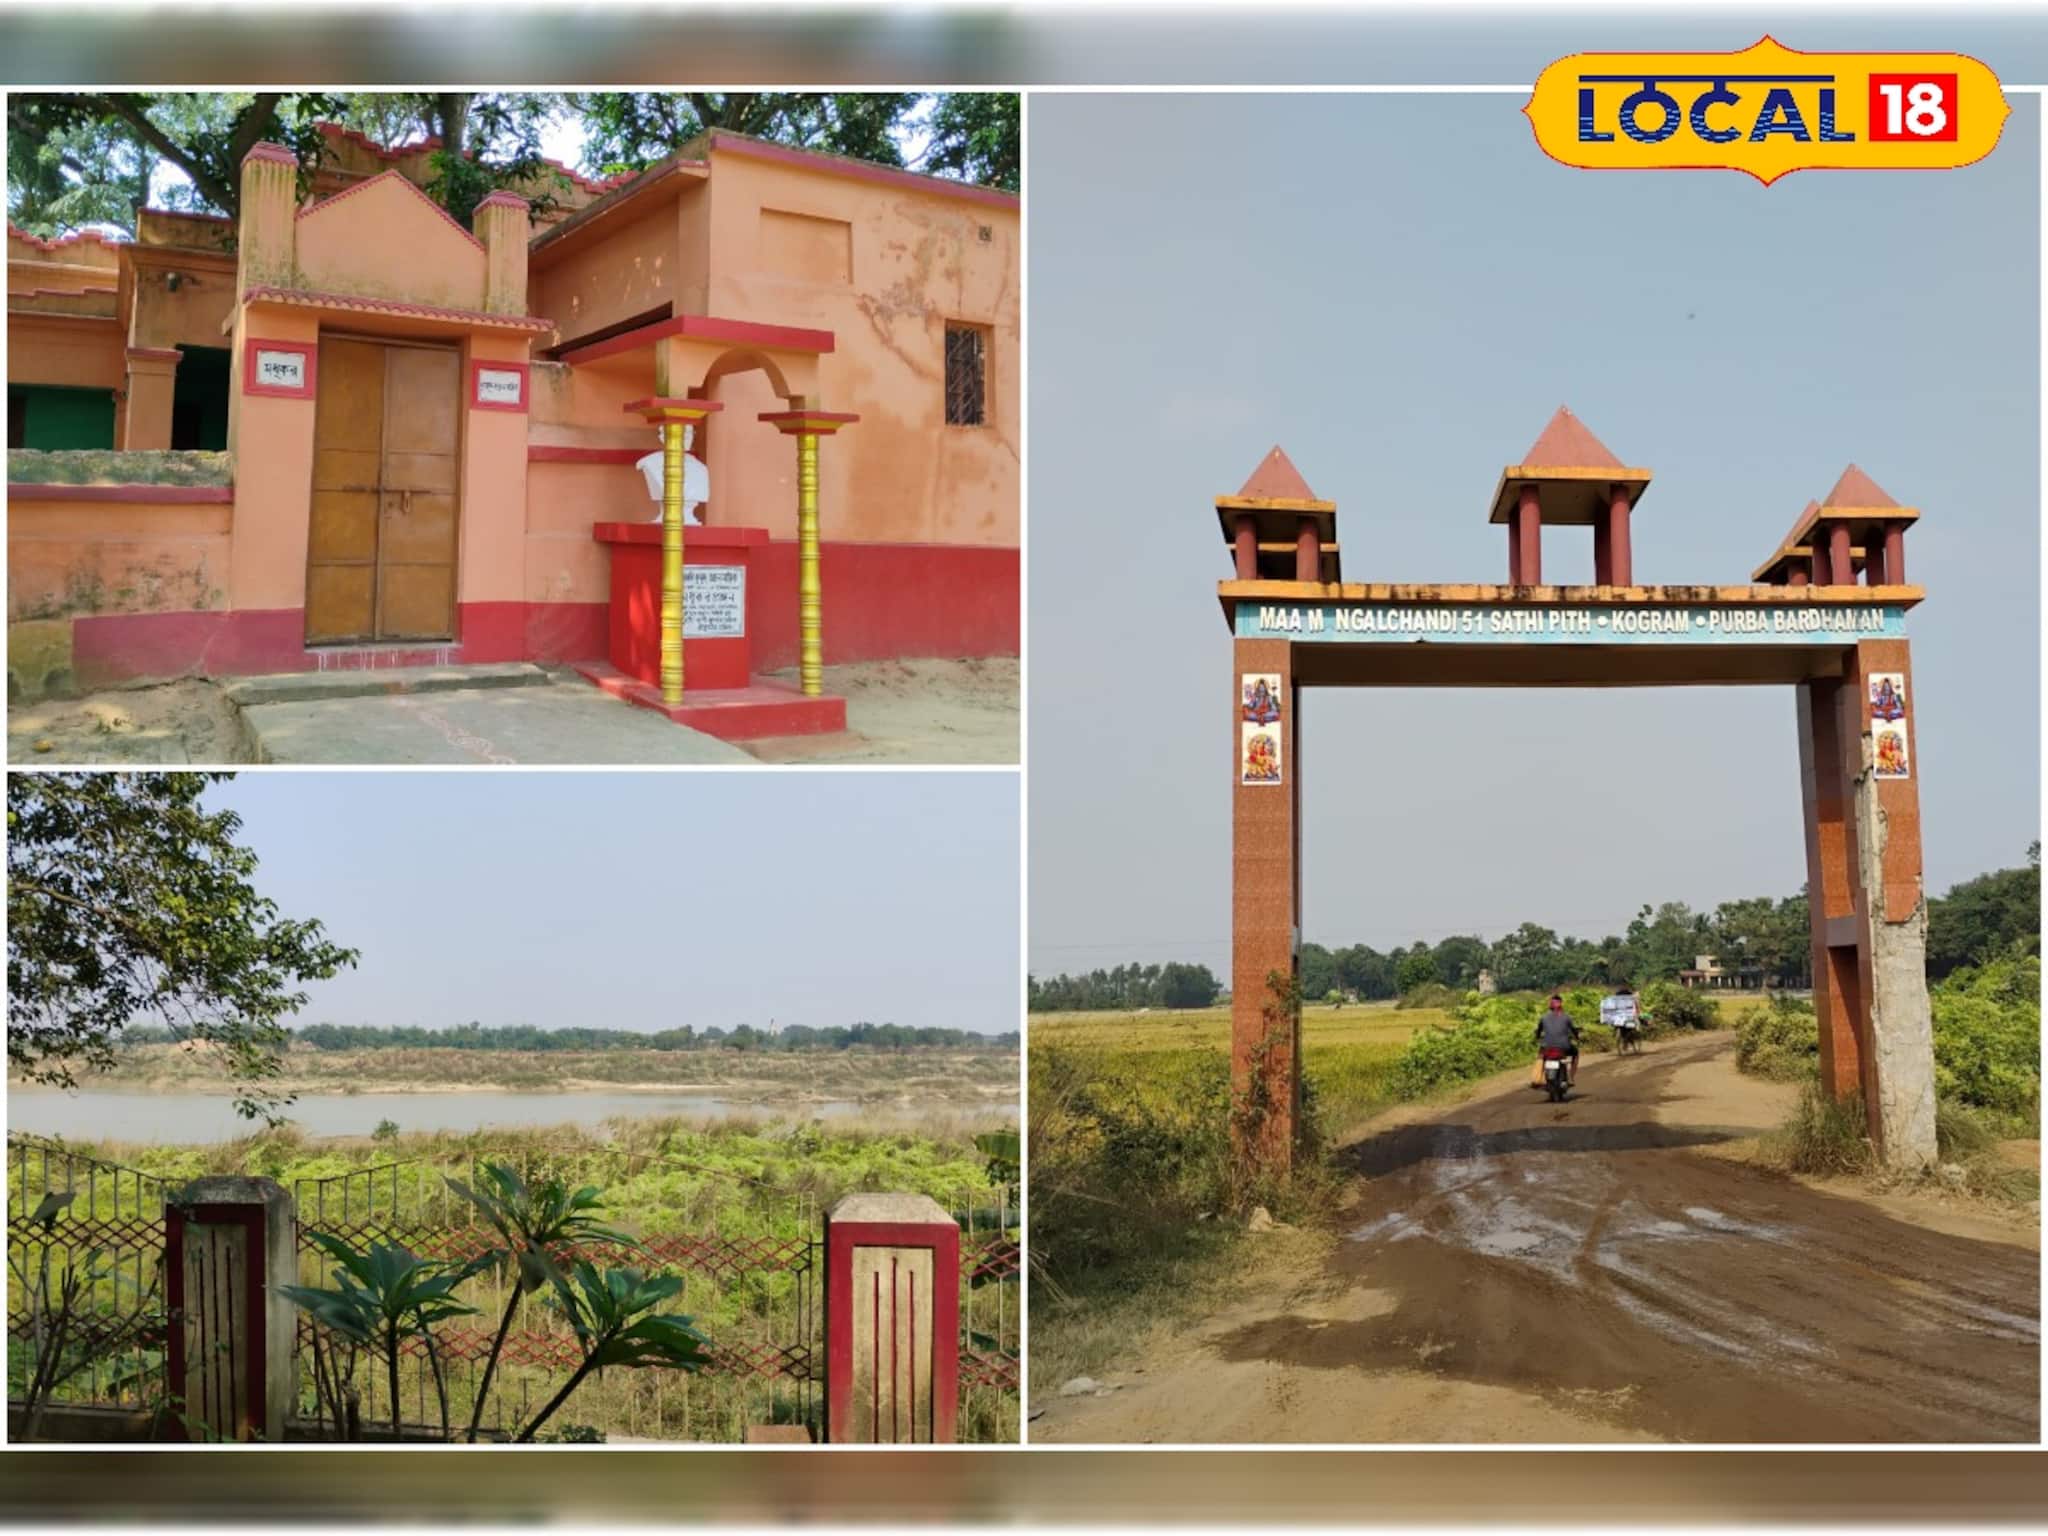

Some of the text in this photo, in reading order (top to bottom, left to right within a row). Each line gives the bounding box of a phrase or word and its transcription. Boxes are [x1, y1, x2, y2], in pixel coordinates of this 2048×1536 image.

[1260, 607, 1301, 631] MAA
[1462, 610, 1483, 632] 51
[1490, 609, 1544, 633] SATHI
[1550, 609, 1591, 633] PITH
[1612, 610, 1689, 633] KOGRAM
[1709, 610, 1768, 632] PURBA
